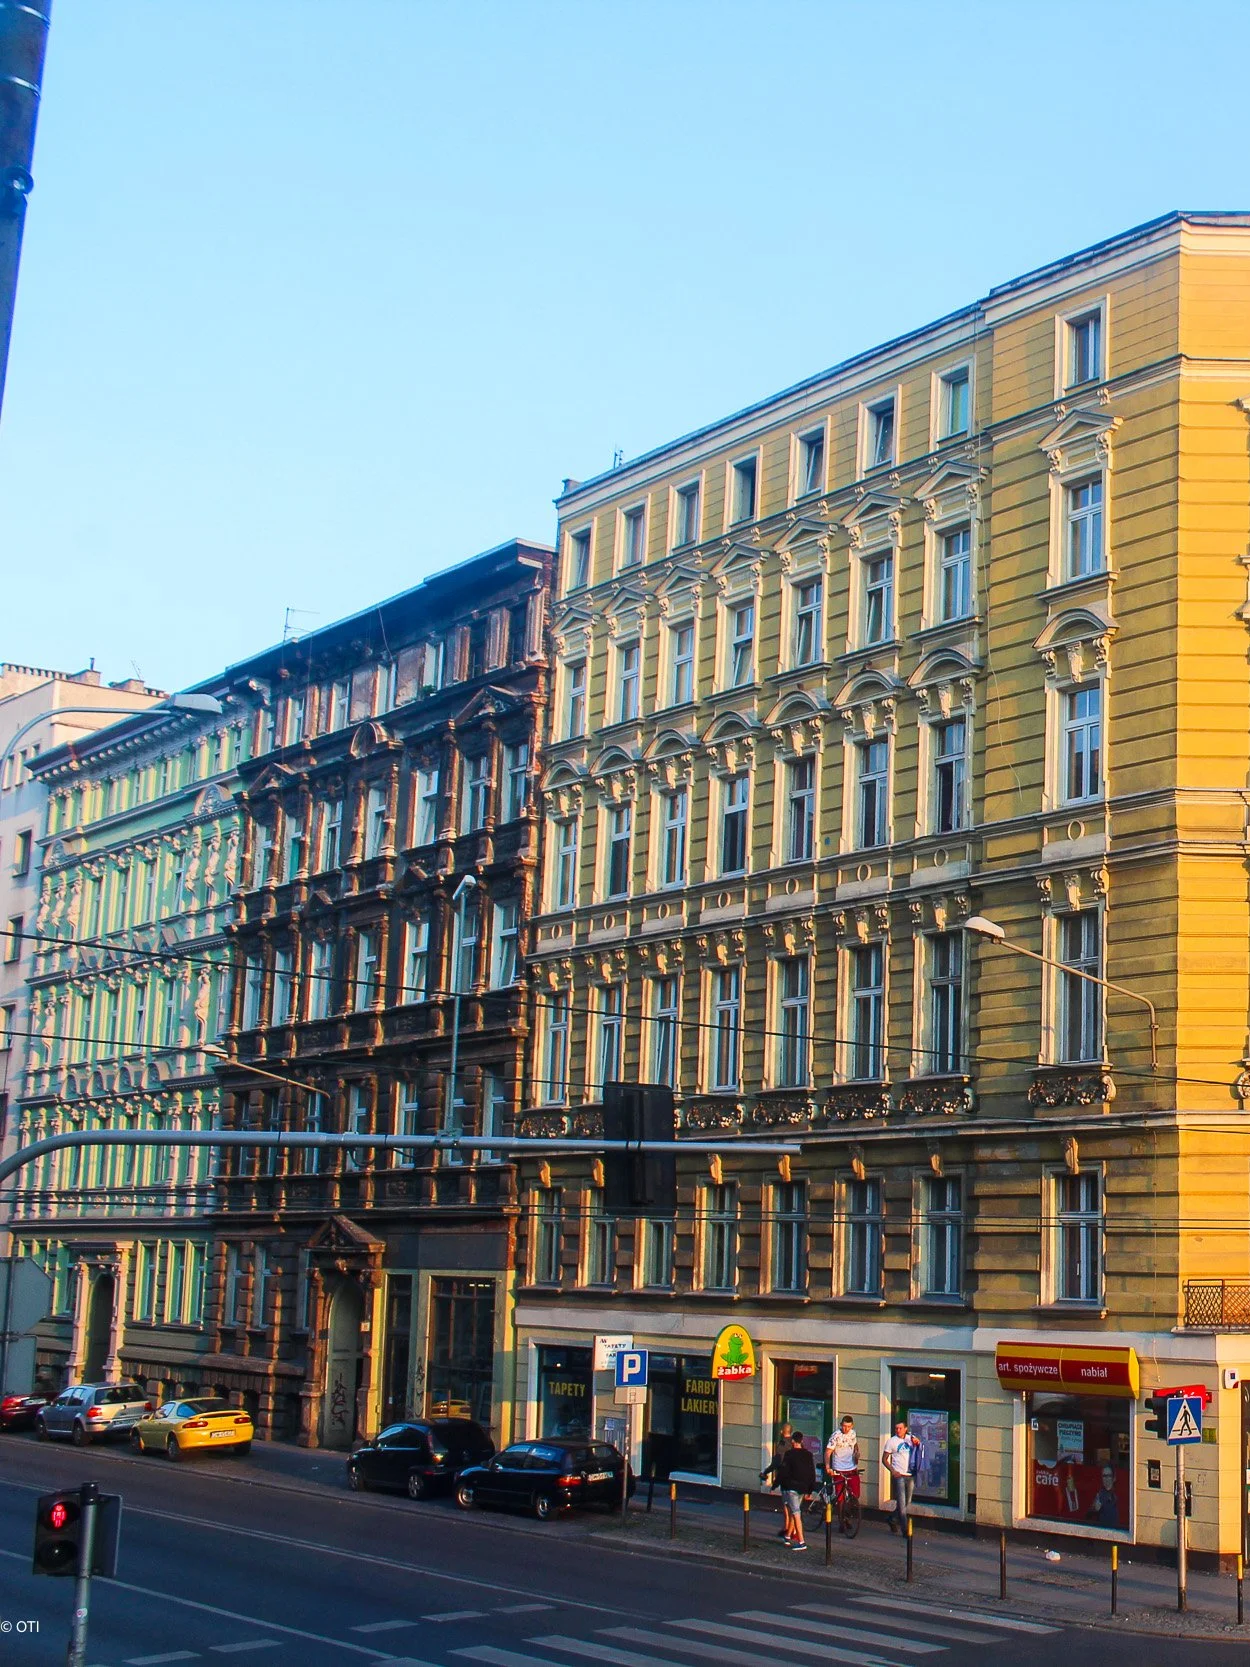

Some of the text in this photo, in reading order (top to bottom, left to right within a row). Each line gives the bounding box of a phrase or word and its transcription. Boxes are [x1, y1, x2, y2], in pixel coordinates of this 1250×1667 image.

[623, 1353, 641, 1382] P
[718, 1365, 752, 1376] żabka
[998, 1362, 1059, 1375] art. spożywcze
[1081, 1366, 1109, 1378] nabiał
[549, 1381, 586, 1397] TAPETY
[686, 1379, 717, 1395] FARBY
[681, 1397, 719, 1415] LAKIER
[1036, 1473, 1059, 1486] café
